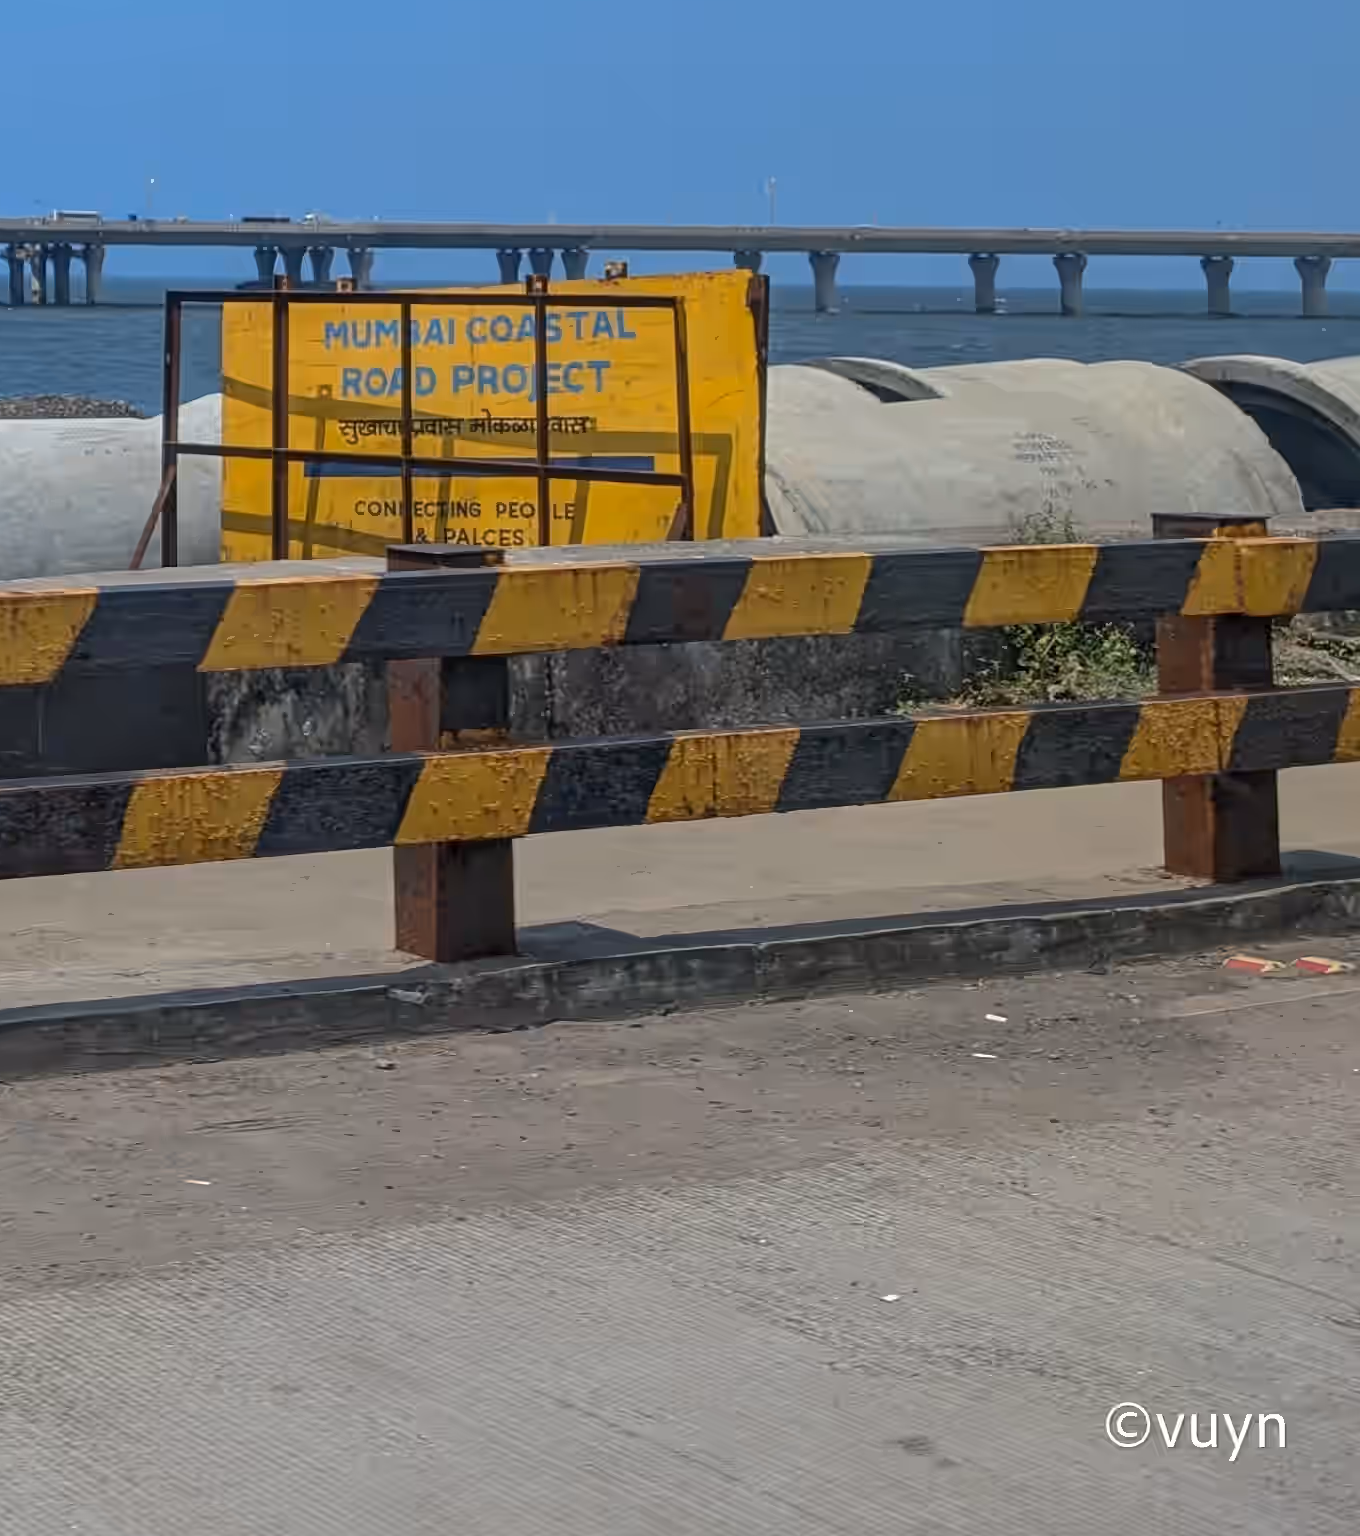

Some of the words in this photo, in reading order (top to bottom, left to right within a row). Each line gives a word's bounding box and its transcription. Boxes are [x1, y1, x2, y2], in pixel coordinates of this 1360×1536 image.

[324, 319, 455, 349] MUMBAI
[465, 307, 637, 344] COASTAL
[342, 366, 437, 398] ROAD
[452, 361, 611, 402] PROJECT
[354, 500, 482, 519] CONECTING
[496, 501, 576, 520] PEOLE
[415, 527, 428, 545] &
[444, 527, 525, 546] PALCES
